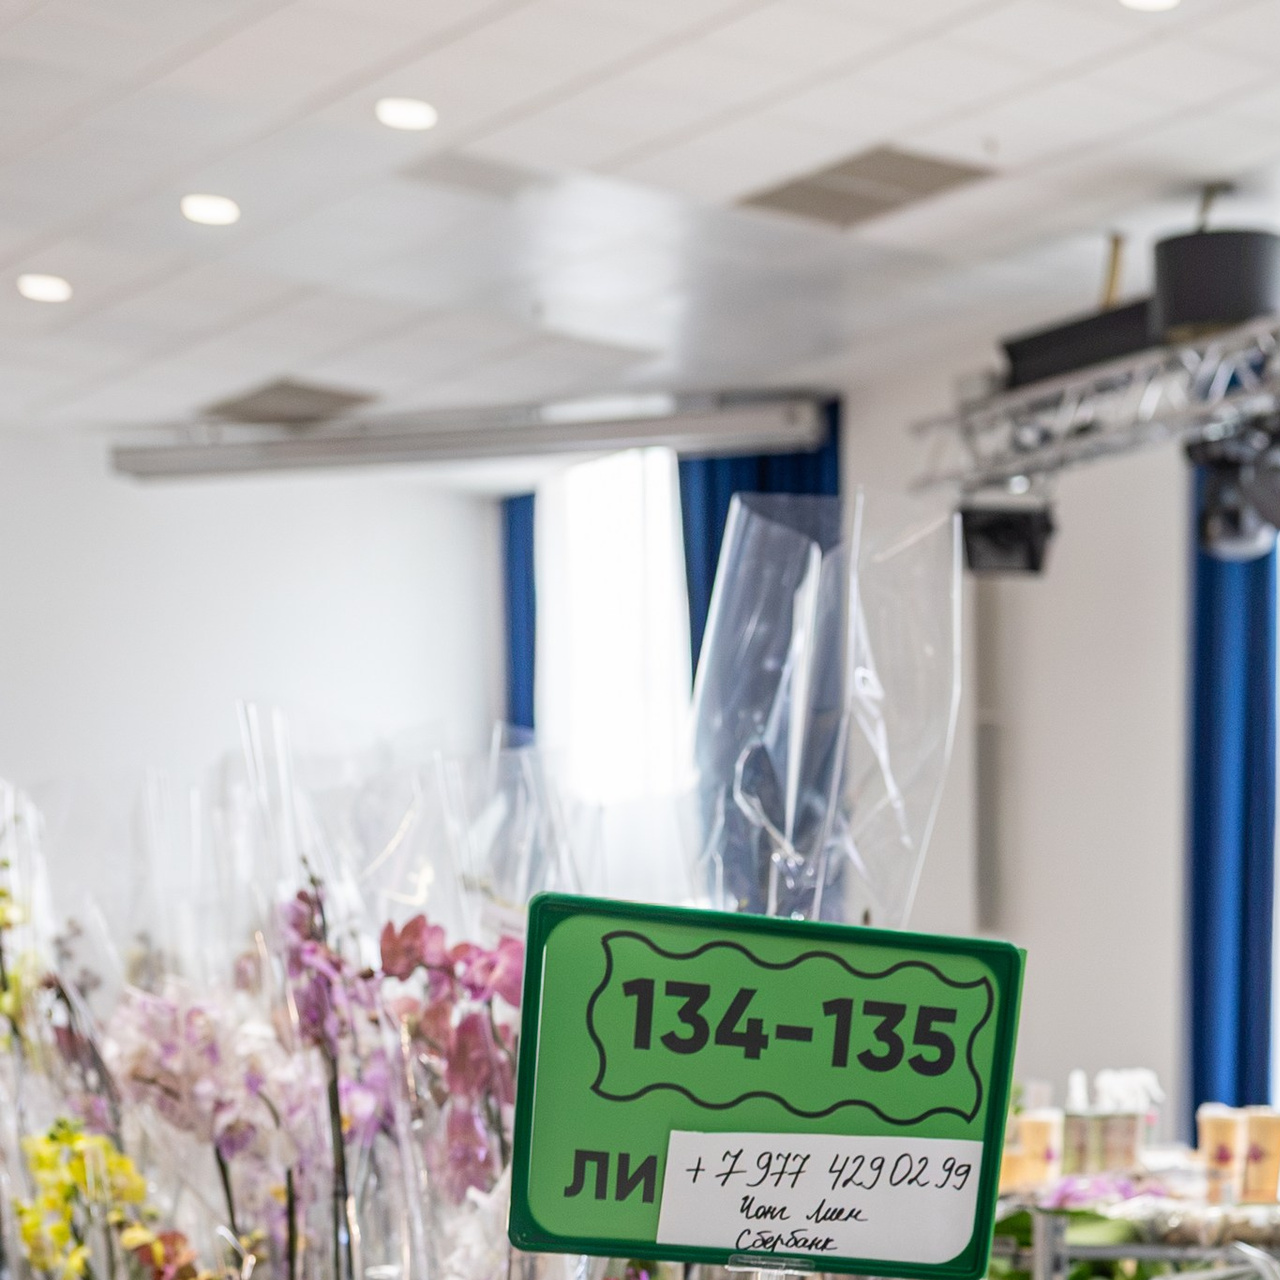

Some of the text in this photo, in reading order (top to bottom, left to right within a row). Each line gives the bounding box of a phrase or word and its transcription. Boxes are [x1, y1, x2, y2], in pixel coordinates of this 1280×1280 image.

[621, 977, 958, 1077] 134-135
[563, 1148, 658, 1205] ЛИ
[735, 1228, 838, 1253] Сбербанк
